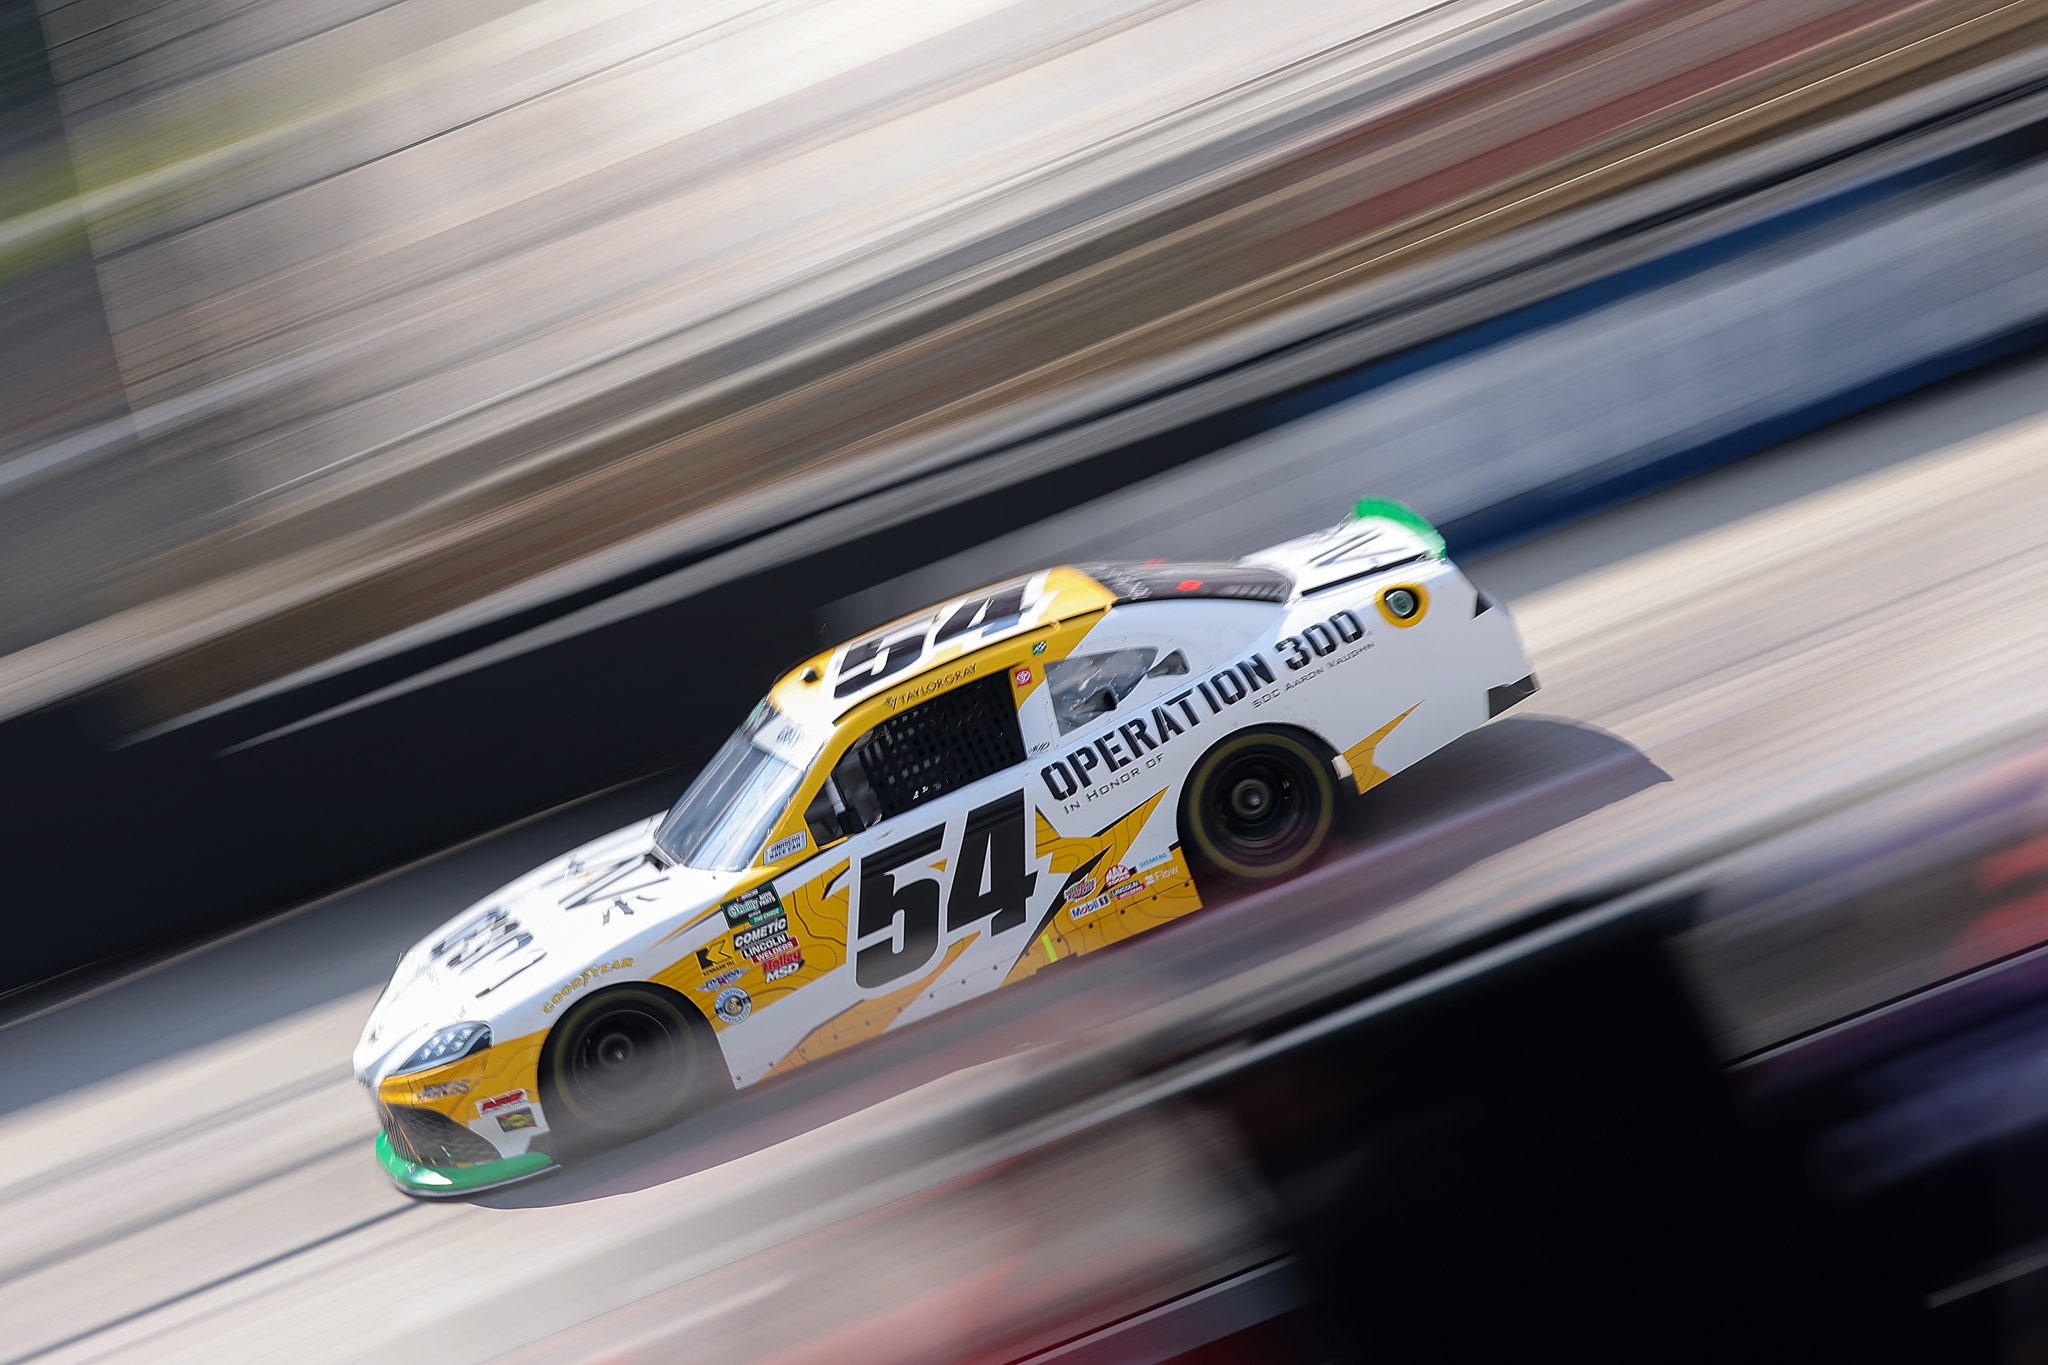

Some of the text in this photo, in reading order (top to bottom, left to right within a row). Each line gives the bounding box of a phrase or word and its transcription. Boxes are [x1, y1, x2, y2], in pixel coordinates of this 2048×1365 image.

[1040, 609, 1367, 802] OPERATION 300
[1063, 753, 1166, 815] IN HONOR OF
[855, 787, 1039, 989] 54
[1072, 900, 1099, 919] Mobil
[734, 917, 787, 948] COMETIC
[743, 933, 786, 959] LINCOLN
[755, 941, 794, 962] WELDERS
[543, 957, 634, 1014] GOODYEAR
[765, 961, 800, 984] MSD
